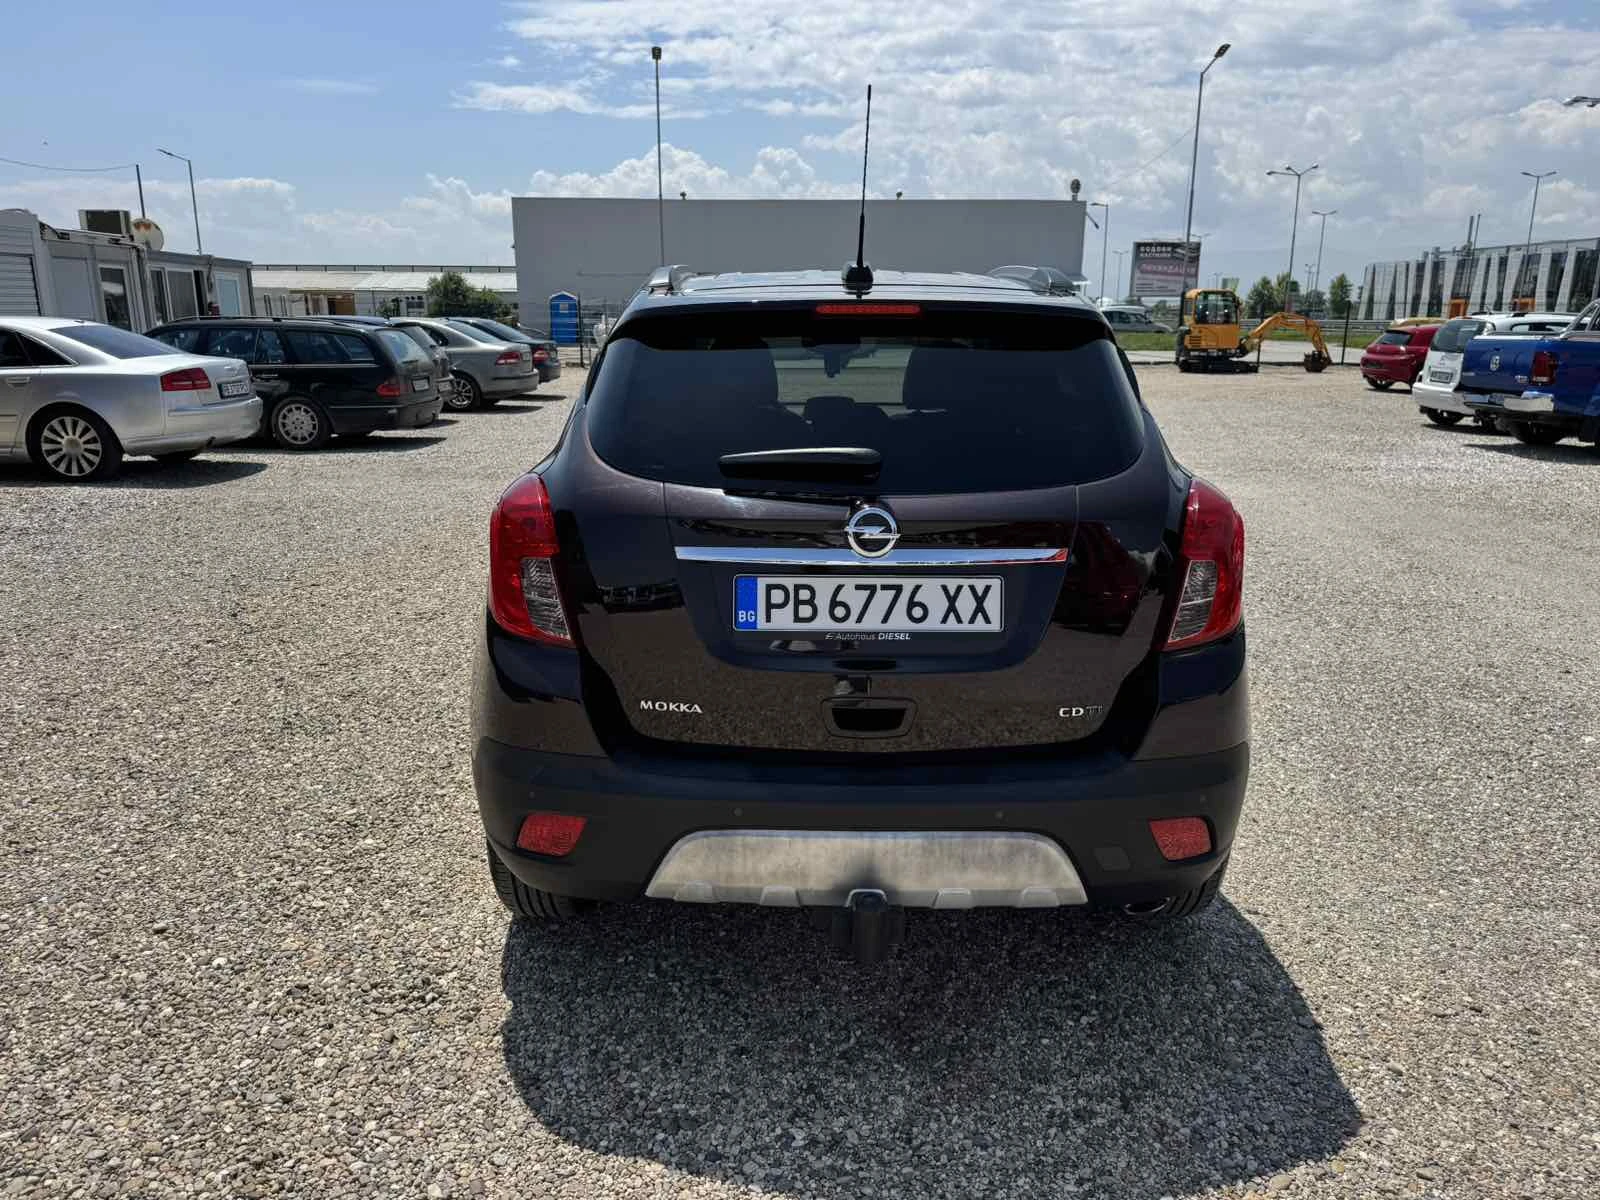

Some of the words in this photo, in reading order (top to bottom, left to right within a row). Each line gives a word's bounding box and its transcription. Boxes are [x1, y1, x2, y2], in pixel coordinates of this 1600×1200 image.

[765, 583, 818, 624] PB
[828, 583, 929, 625] 6776
[940, 584, 993, 625] XX
[738, 610, 756, 622] BG
[878, 632, 911, 640] DIESEL
[640, 700, 704, 714] MOKKA
